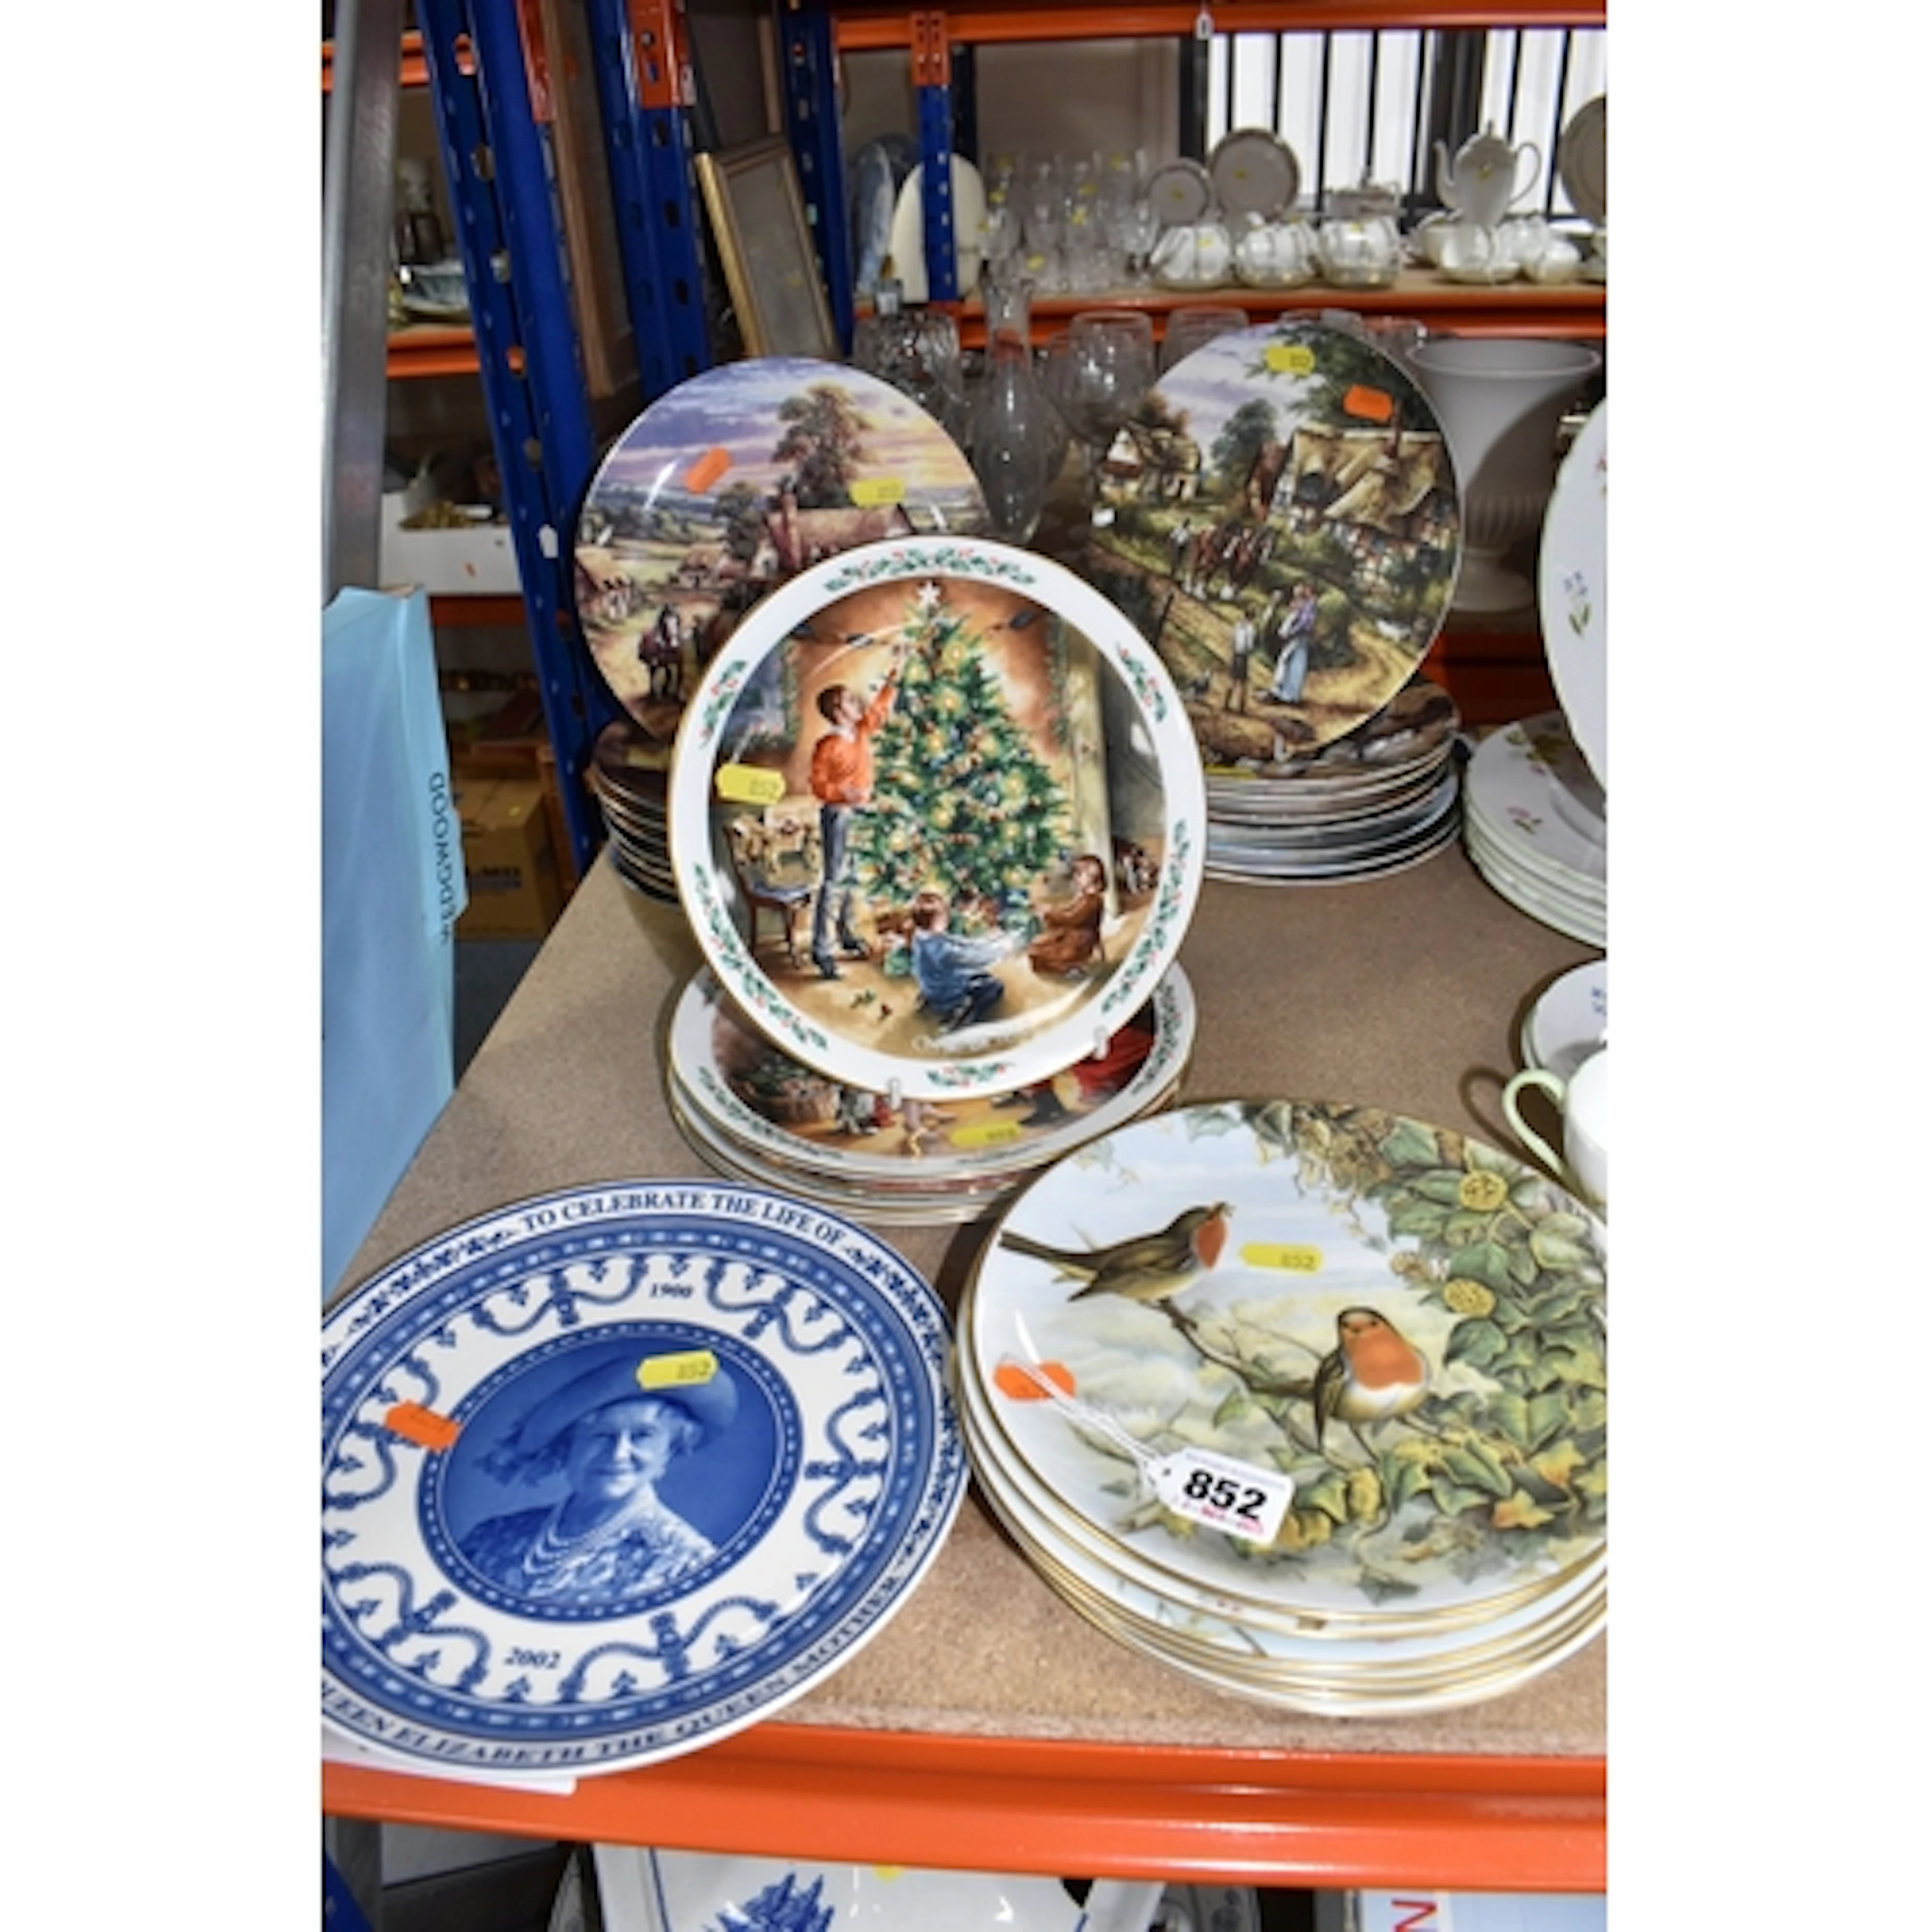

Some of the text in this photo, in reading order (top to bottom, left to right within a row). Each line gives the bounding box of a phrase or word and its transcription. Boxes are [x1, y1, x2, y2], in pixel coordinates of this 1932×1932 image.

[520, 1192, 847, 1245] TO CELEBRATE THE LIFE OF
[1183, 1468, 1267, 1520] 852
[503, 1646, 561, 1669] 2002
[394, 1726, 585, 1761] ELIZABETH
[597, 1731, 663, 1756] THE
[675, 1677, 789, 1734] QUEEN
